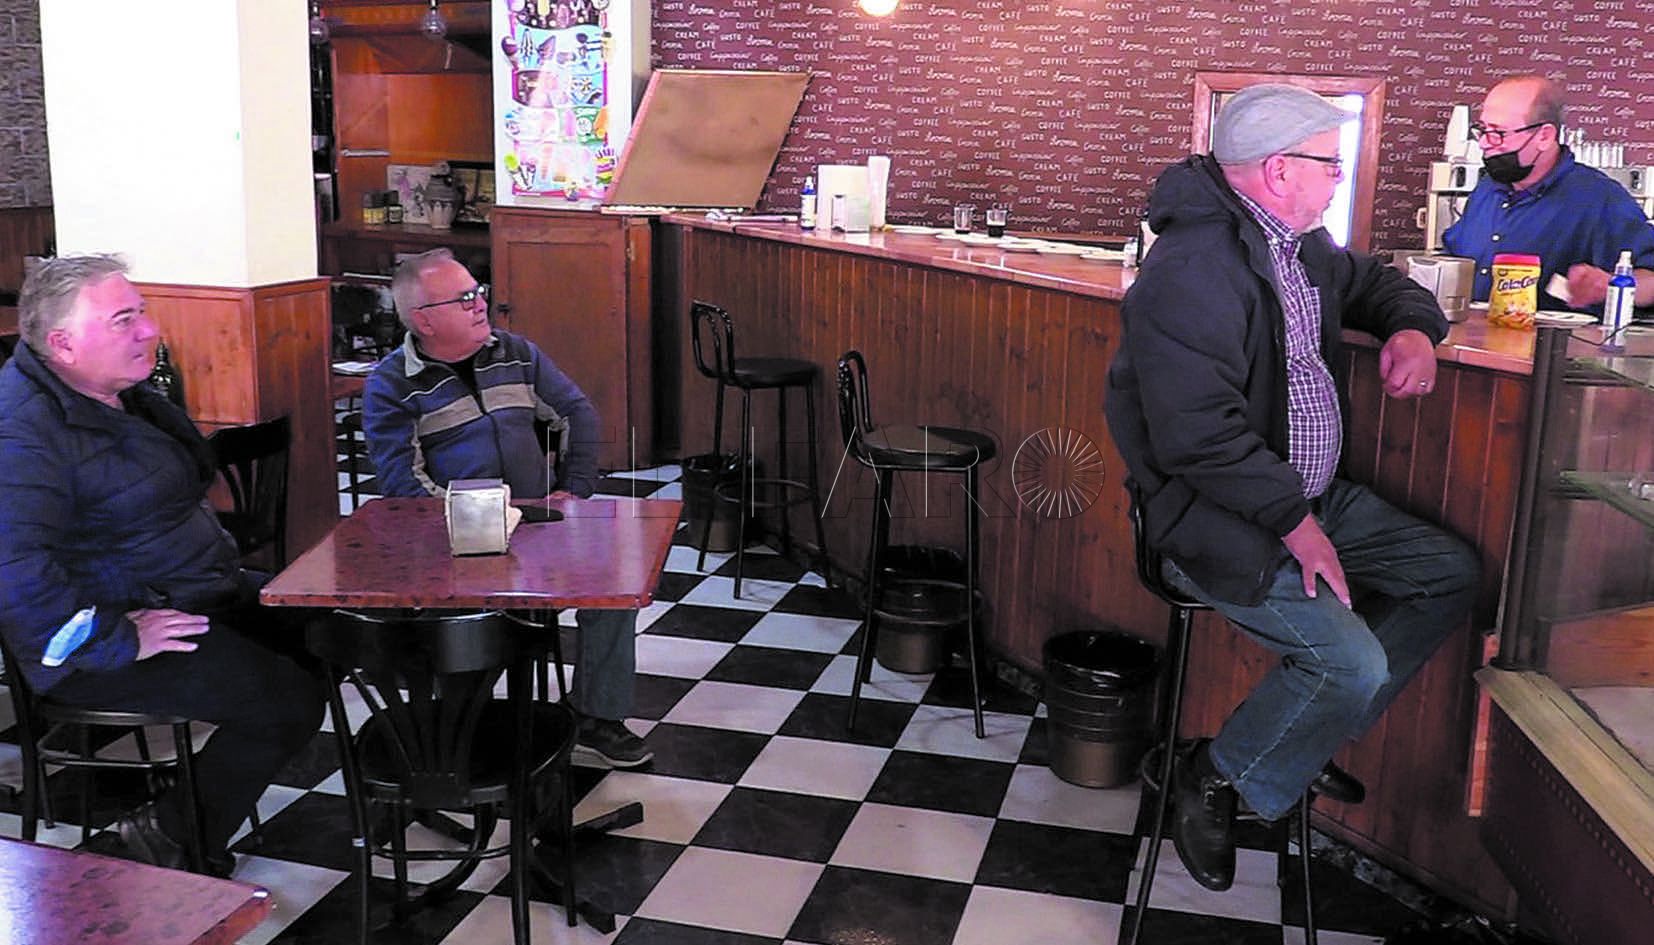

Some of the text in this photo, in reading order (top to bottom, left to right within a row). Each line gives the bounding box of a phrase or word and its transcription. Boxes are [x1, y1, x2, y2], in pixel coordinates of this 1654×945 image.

[779, 2, 801, 10] GUSTO
[977, 1, 1004, 9] CREAM
[1105, 2, 1133, 11] CREAM
[1238, 4, 1267, 13] CREAM
[1594, 1, 1624, 10] COFFEE
[1376, 7, 1406, 15] CREAM
[1430, 11, 1456, 19] GUSTO
[1517, 10, 1548, 18] CREAM
[1573, 14, 1600, 22] GUSTO
[735, 22, 760, 30] COFFEE
[978, 24, 1005, 32] COFFEE
[1107, 26, 1134, 34] COFFEE
[674, 30, 700, 38] CREAM
[791, 31, 818, 39] CREAM
[913, 32, 940, 41] CREAM
[1240, 28, 1268, 37] COFFEE
[1377, 31, 1406, 40] COFFEE
[720, 33, 742, 41] GUSTO
[838, 34, 861, 42] GUSTO
[1039, 34, 1067, 42] CREAM
[1169, 36, 1198, 45] CREAM
[1518, 34, 1548, 43] COFFEE
[1221, 40, 1246, 48] GUSTO
[1304, 39, 1333, 48] CREAM
[1358, 43, 1383, 51] GUSTO
[1443, 42, 1473, 51] CREAM
[1498, 47, 1524, 55] GUSTO
[1586, 46, 1617, 55] CREAM
[677, 52, 702, 60] COFFEE
[794, 53, 819, 62] COFFEE
[915, 55, 941, 63] COFFEE
[1041, 57, 1068, 66] COFFEE
[1171, 60, 1198, 68] COFFEE
[732, 62, 758, 70] CREAM
[851, 63, 877, 71] CREAM
[974, 65, 1001, 74] CREAM
[1305, 63, 1334, 72] COFFEE
[1023, 69, 1047, 77] GUSTO
[1102, 68, 1130, 76] CREAM
[1444, 67, 1473, 76] COFFEE
[1586, 71, 1616, 80] COFFEE
[853, 86, 879, 94] COFFEE
[1566, 83, 1593, 92] GUSTO
[976, 88, 1002, 96] COFFEE
[1103, 91, 1131, 99] COFFEE
[911, 96, 938, 104] CREAM
[1036, 99, 1064, 107] CREAM
[913, 118, 939, 127] COFFEE
[1579, 115, 1609, 125] CREAM
[1038, 121, 1065, 130] COFFEE
[850, 126, 876, 134] CREAM
[972, 129, 999, 137] CREAM
[1021, 133, 1044, 141] GUSTO
[1099, 132, 1127, 141] CREAM
[1149, 137, 1173, 145] GUSTO
[852, 148, 877, 156] COFFEE
[1419, 146, 1444, 154] GUSTO
[790, 155, 816, 163] CREAM
[974, 151, 1000, 160] COFFEE
[1100, 155, 1127, 164] COFFEE
[910, 158, 936, 167] CREAM
[1034, 162, 1061, 171] CREAM
[1083, 167, 1107, 175] GUSTO
[912, 181, 937, 189] COFFEE
[1035, 185, 1062, 193] COFFEE
[970, 192, 997, 200] CREAM
[1019, 196, 1042, 204] GUSTO
[1096, 196, 1123, 205] CREAM
[1097, 219, 1124, 228] COFFEE
